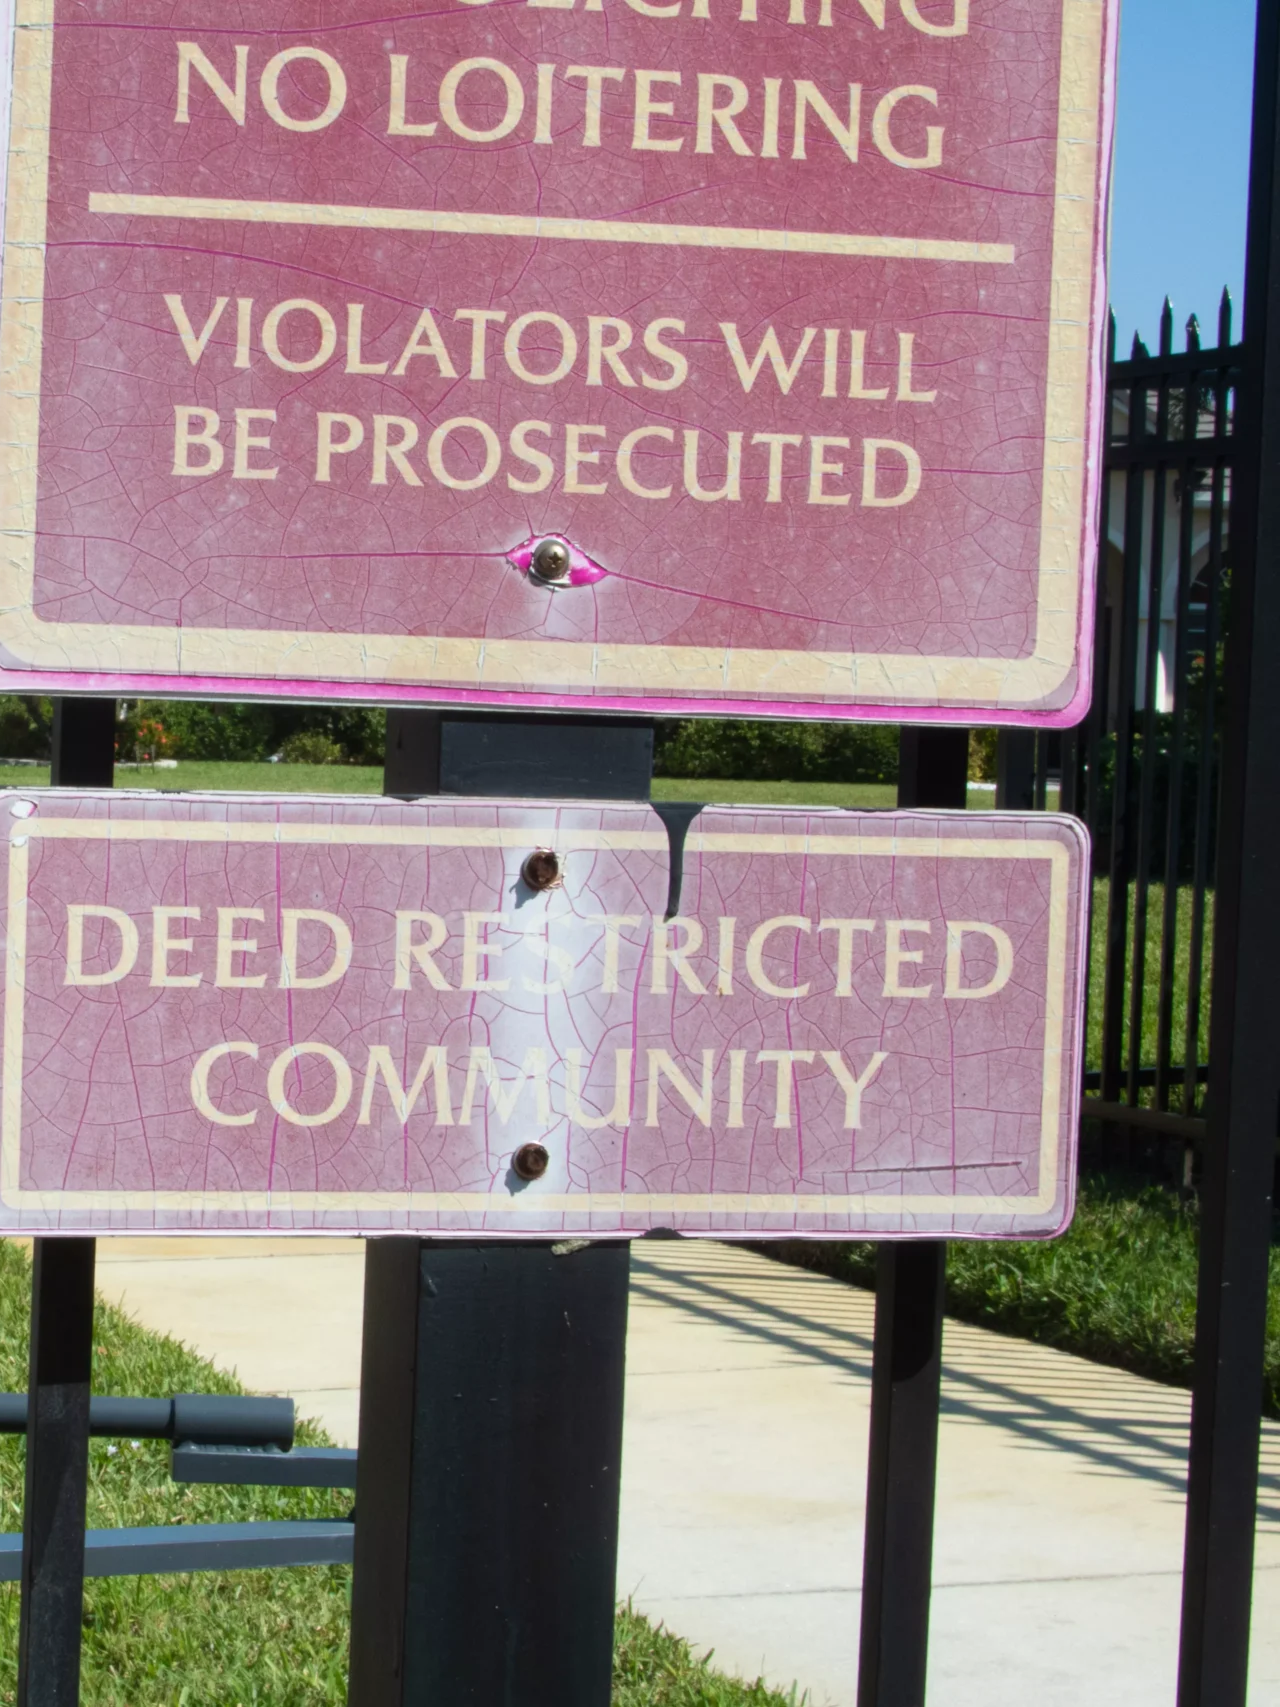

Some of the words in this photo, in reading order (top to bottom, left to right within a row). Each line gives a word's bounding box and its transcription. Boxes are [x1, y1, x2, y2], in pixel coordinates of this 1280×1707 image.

[174, 41, 347, 132] NO
[387, 54, 945, 168] LOITERING
[164, 294, 689, 392] VIOLATORS
[719, 322, 938, 403] WILL
[170, 405, 280, 481] BE
[315, 411, 923, 508] PROSECUTED
[62, 904, 353, 992] DEED
[392, 908, 1016, 1001] RESTRICTED
[190, 1040, 889, 1131] COMMUNITY
